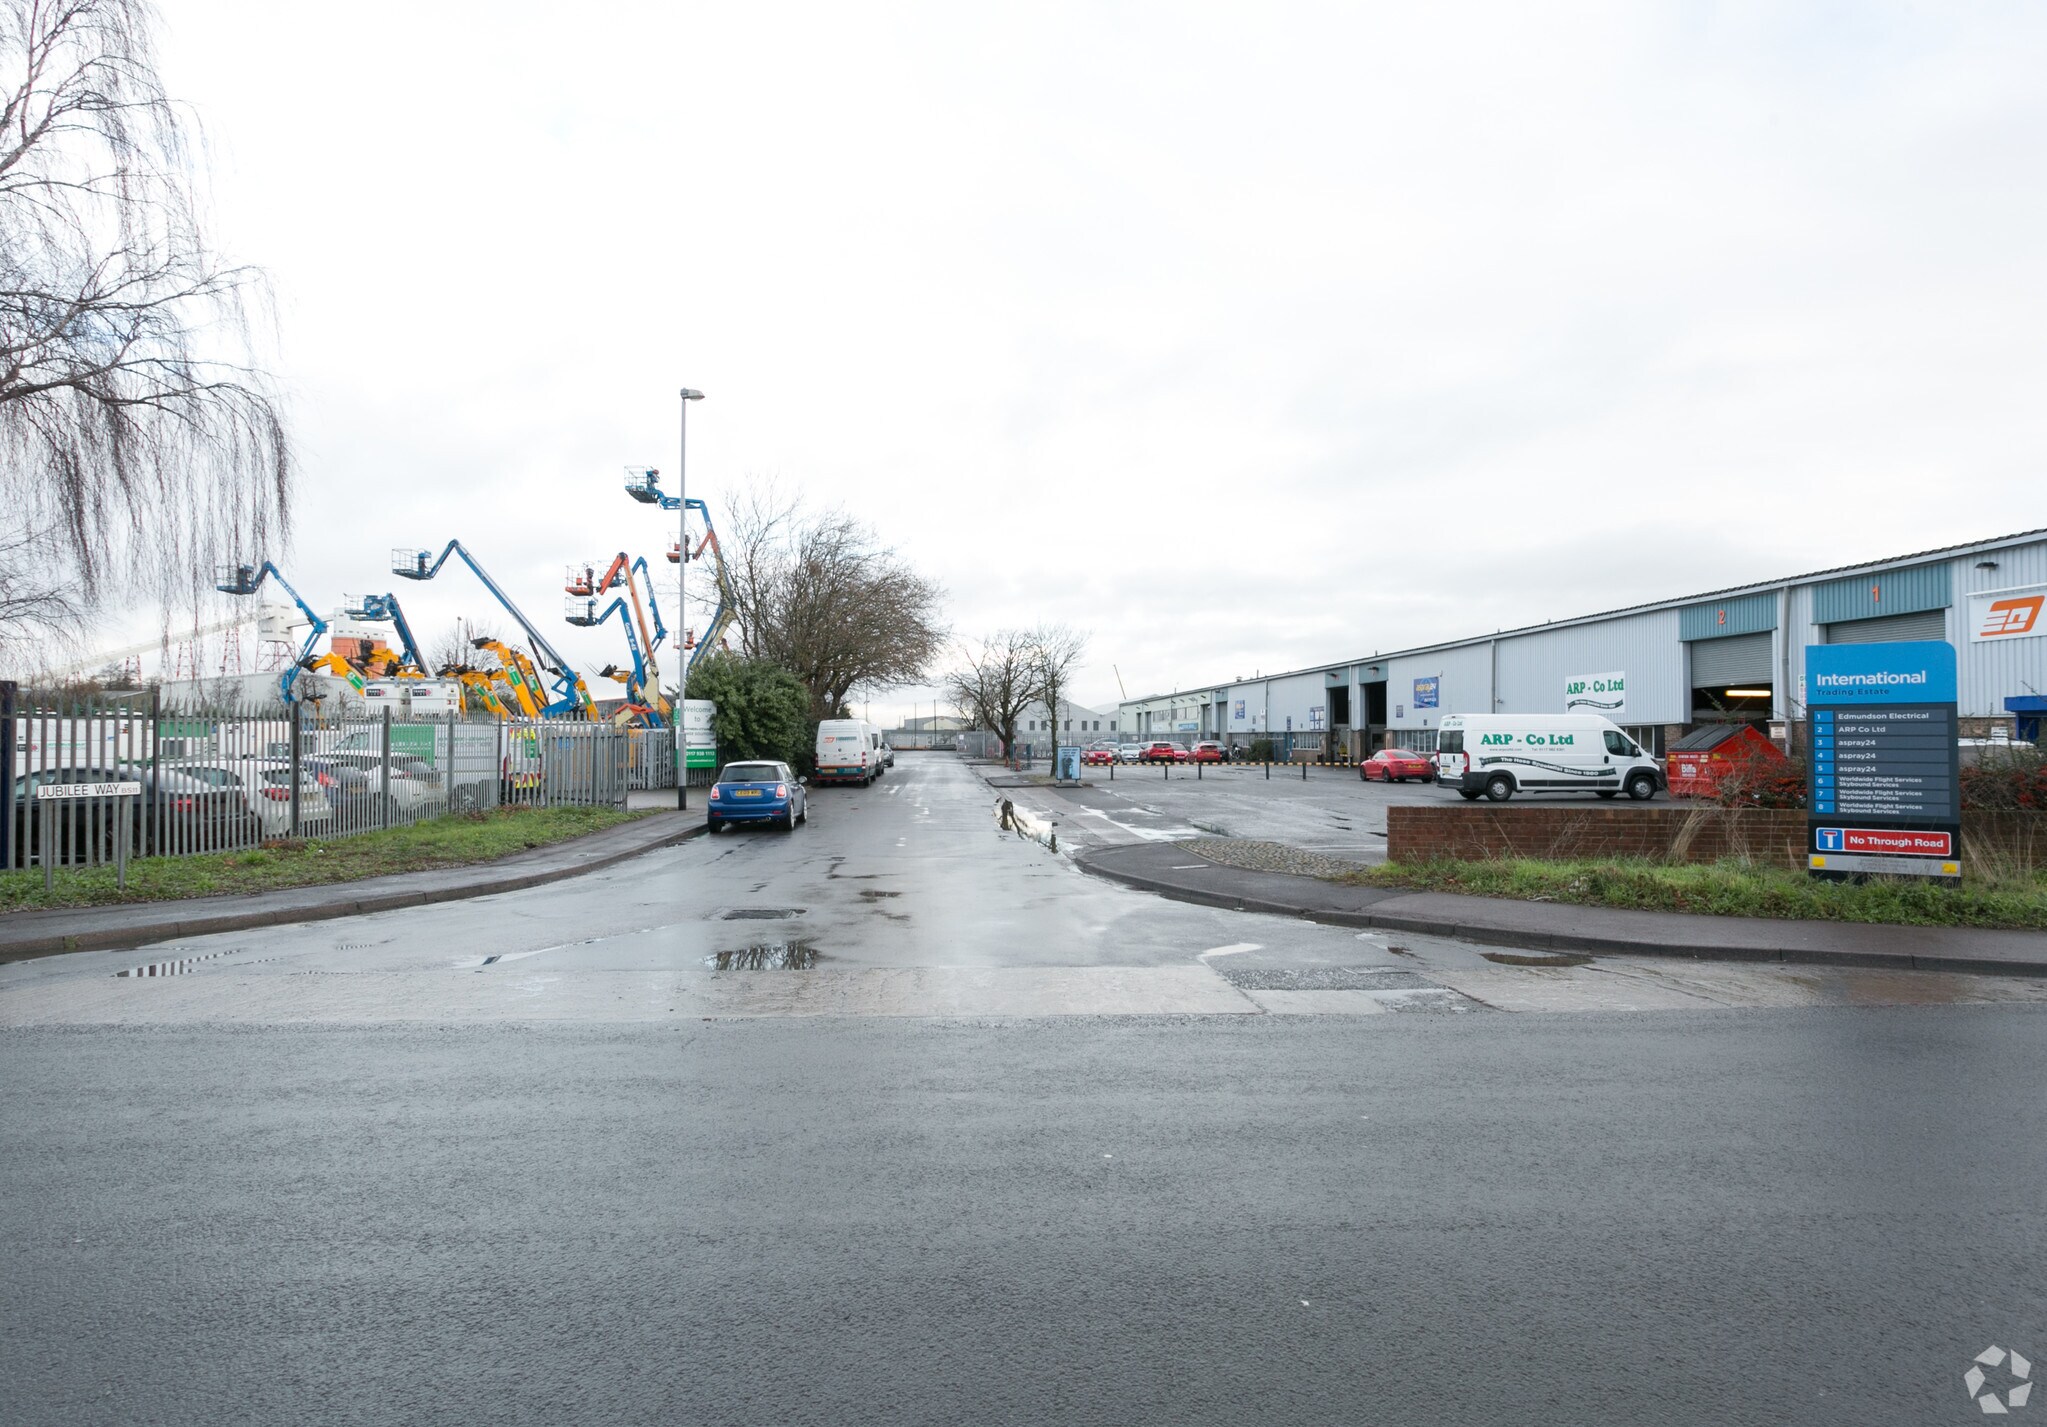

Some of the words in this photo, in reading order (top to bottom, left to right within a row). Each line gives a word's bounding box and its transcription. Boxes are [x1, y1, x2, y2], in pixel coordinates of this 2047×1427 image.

[1871, 586, 1880, 602] 1
[1718, 610, 1725, 625] 2
[1816, 670, 1927, 686] International
[1566, 682, 1586, 694] ARP
[1593, 680, 1605, 692] Co
[1607, 678, 1624, 692] Ltd
[1816, 688, 1854, 696] Trading
[1480, 733, 1513, 745] ARP
[1525, 734, 1546, 745] Co
[1549, 733, 1574, 745] Ltd
[1532, 760, 1563, 772] Specialist
[40, 785, 89, 797] JUBILEE
[94, 784, 120, 795] WAY
[1850, 836, 1865, 844] No
[1867, 836, 1912, 848] Through
[1914, 839, 1944, 848] Road
